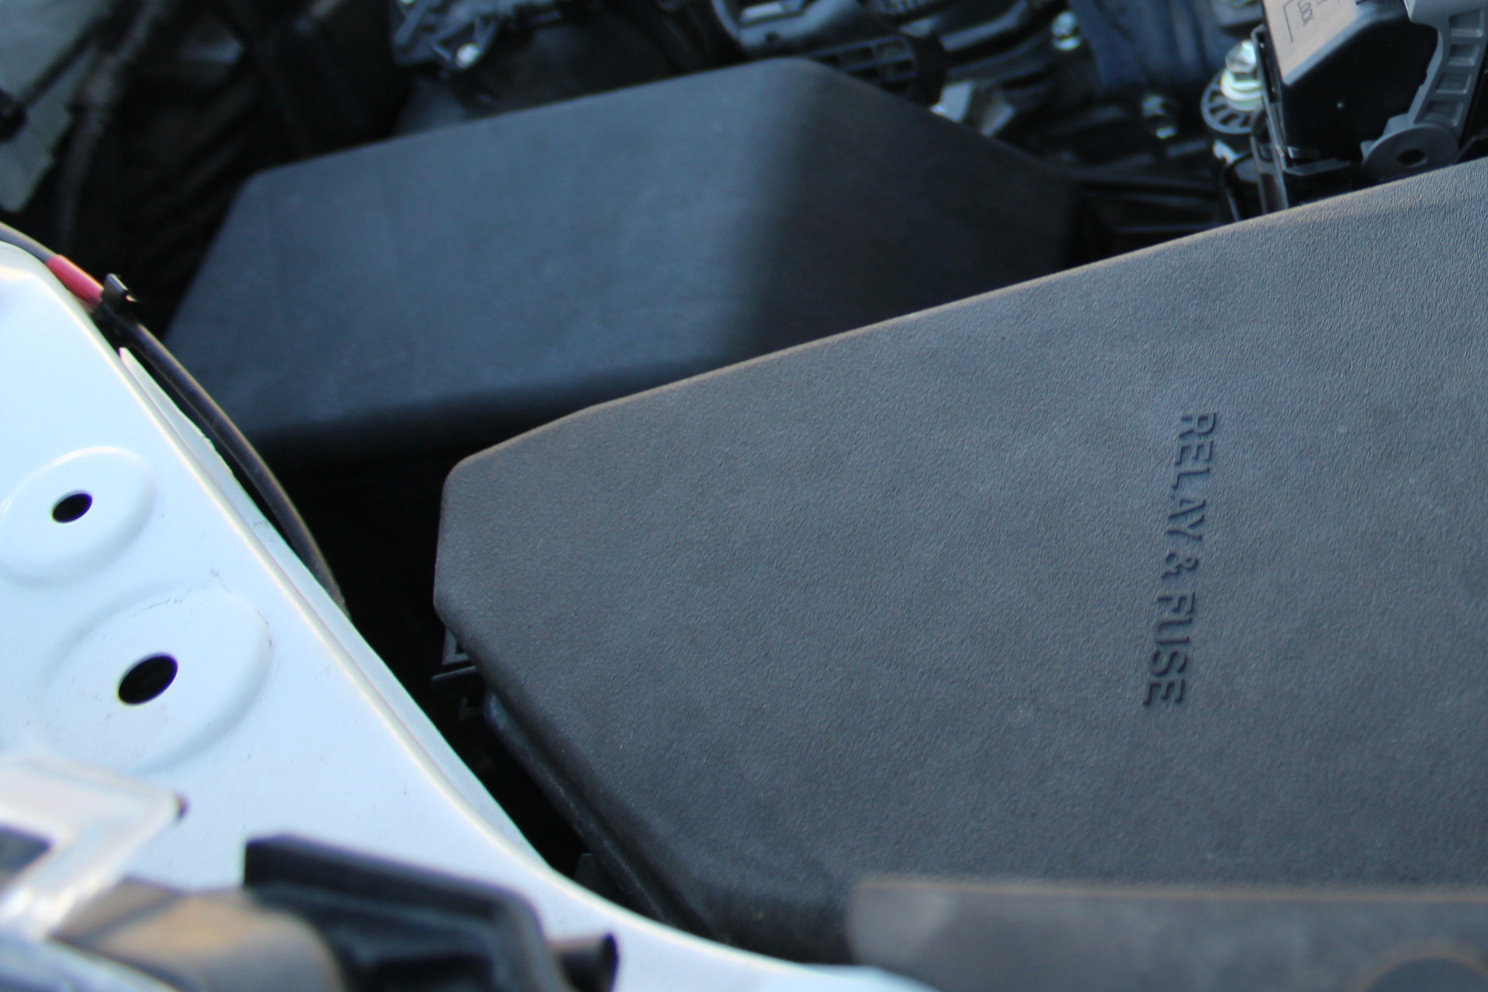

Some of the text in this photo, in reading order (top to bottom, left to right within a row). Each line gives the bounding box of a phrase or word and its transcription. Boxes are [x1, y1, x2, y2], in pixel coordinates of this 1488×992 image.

[1142, 412, 1217, 707] RELAY & FUSE
